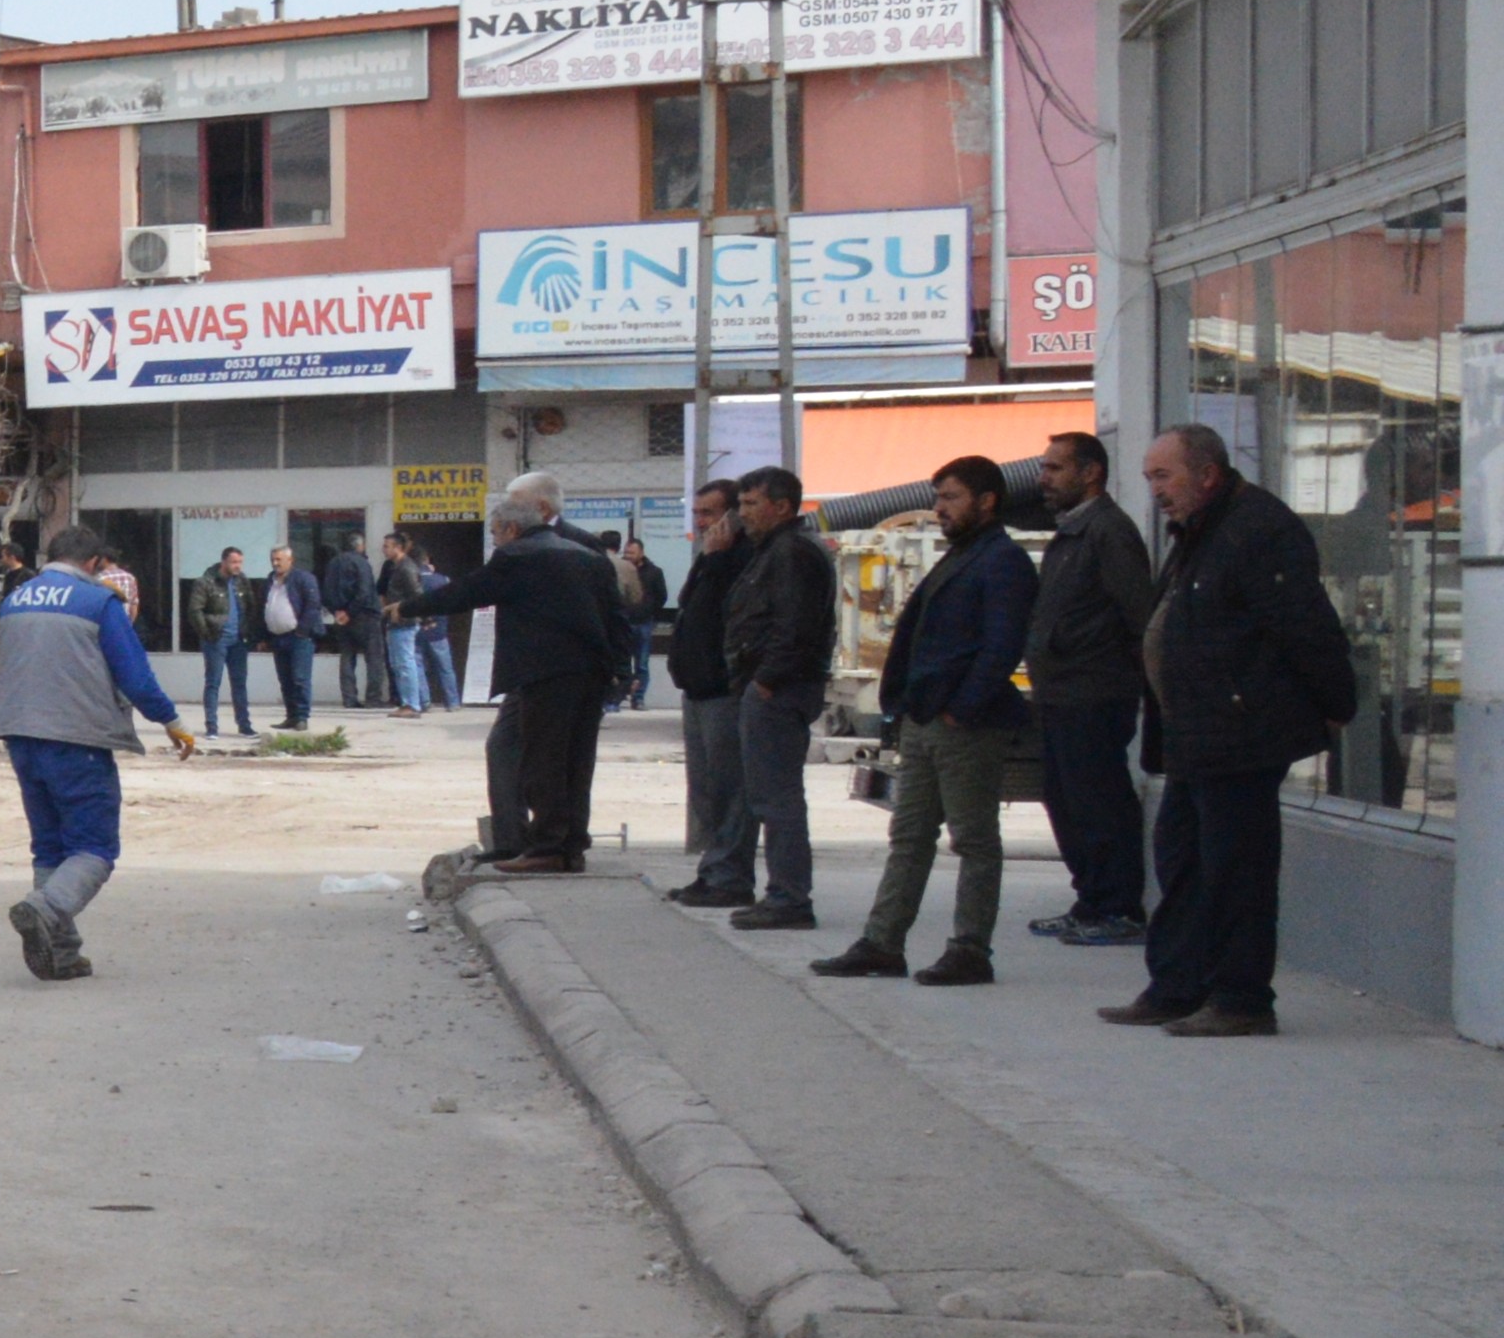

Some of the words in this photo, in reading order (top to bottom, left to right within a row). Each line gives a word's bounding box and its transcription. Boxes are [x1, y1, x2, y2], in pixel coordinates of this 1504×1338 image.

[884, 7, 913, 22] 430
[916, 5, 936, 20] 97
[940, 3, 959, 17] 27
[745, 33, 816, 64] 052
[823, 29, 877, 57] 326
[884, 27, 903, 53] 3
[909, 21, 967, 51] 444
[495, 59, 559, 88] 0352
[566, 56, 617, 83] 326
[625, 52, 642, 78] 3
[648, 47, 701, 75] 444
[129, 302, 249, 351] SAVAŞ
[262, 286, 433, 339] NAKLİYAT
[224, 357, 256, 370] 0533
[258, 356, 282, 369] 689
[284, 355, 302, 367] 43
[304, 354, 322, 366] 12
[153, 373, 178, 385] TEL:
[179, 371, 206, 384] 0352
[207, 370, 228, 382] 326
[230, 369, 258, 381] 9730
[272, 368, 299, 380] FAX:
[300, 366, 328, 379] 0352
[329, 365, 353, 377] 326
[354, 364, 370, 376] 97
[370, 363, 386, 375] 32
[397, 468, 484, 486] BAKTIR
